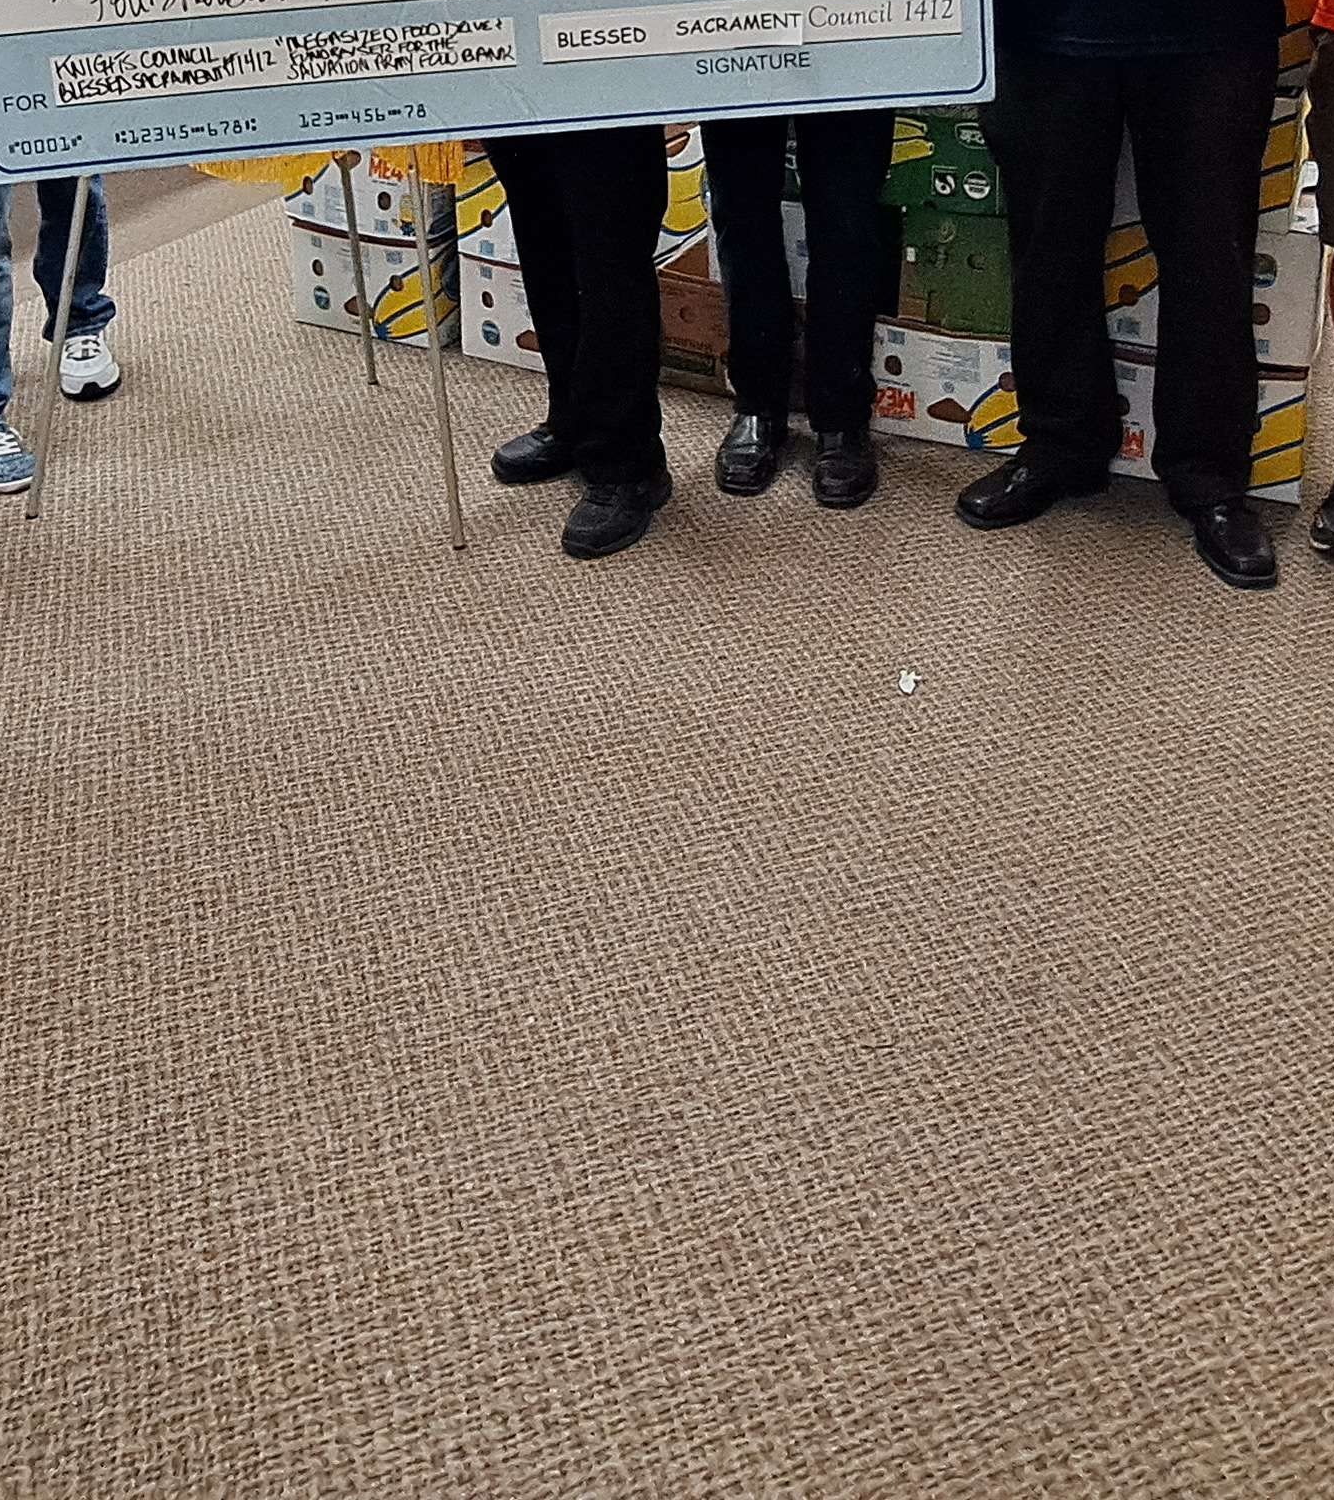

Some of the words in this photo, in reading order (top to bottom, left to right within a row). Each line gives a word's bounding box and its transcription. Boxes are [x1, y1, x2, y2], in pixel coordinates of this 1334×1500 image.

[557, 26, 647, 49] BLESSED
[675, 11, 802, 37] SACRAMENT
[807, 0, 892, 29] Council
[424, 36, 459, 52] THE
[55, 49, 138, 80] KNIGHTS
[140, 46, 220, 70] COUNCIL
[286, 55, 369, 81] SALVATION
[375, 52, 415, 72] ARMY
[462, 43, 516, 64] BANK
[695, 50, 812, 76] SIGNATURE
[2, 92, 48, 114] FOR
[58, 76, 133, 104] BLESSED
